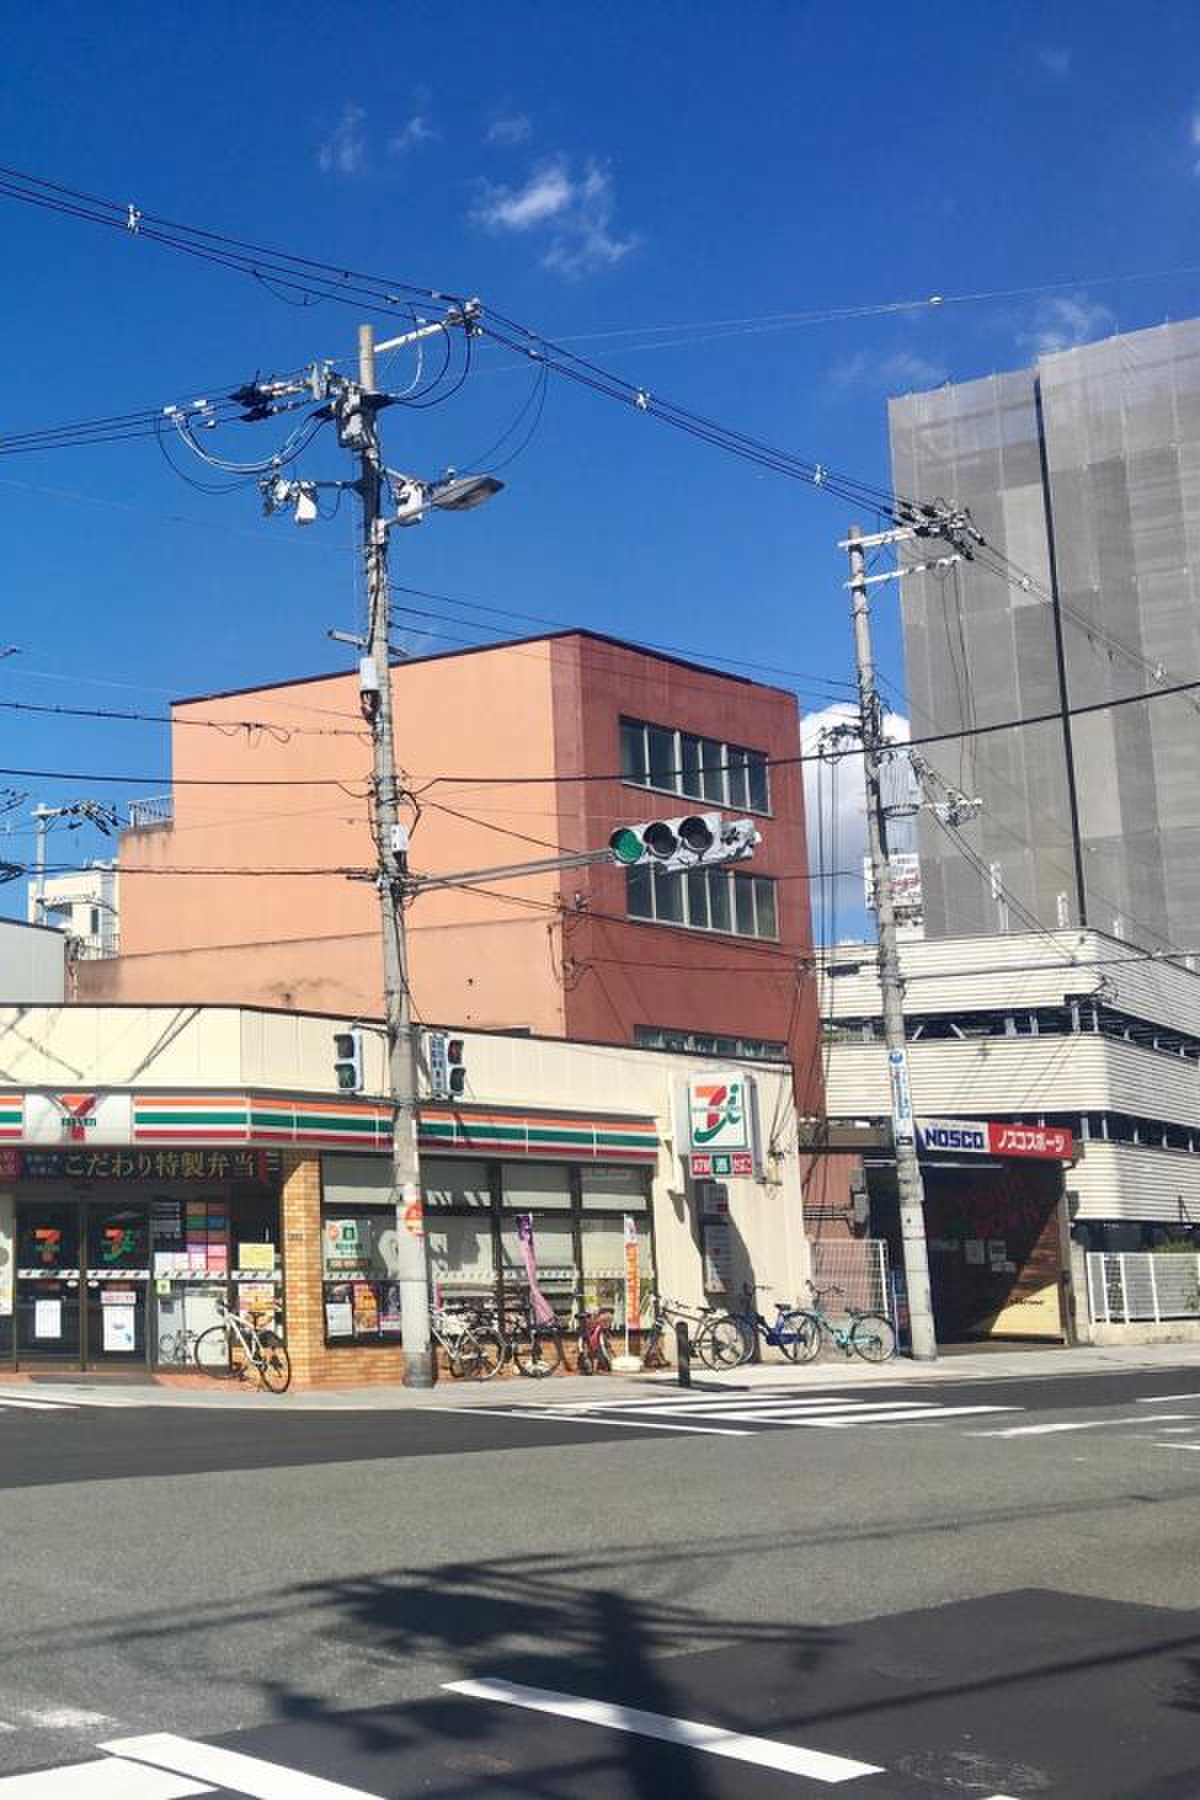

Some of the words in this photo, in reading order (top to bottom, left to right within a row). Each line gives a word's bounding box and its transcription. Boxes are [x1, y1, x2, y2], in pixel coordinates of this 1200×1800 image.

[925, 1127, 985, 1149] NOSCO
[997, 1130, 1065, 1153] ノスコスポーツ
[65, 1151, 255, 1178] こだわり特製弁当
